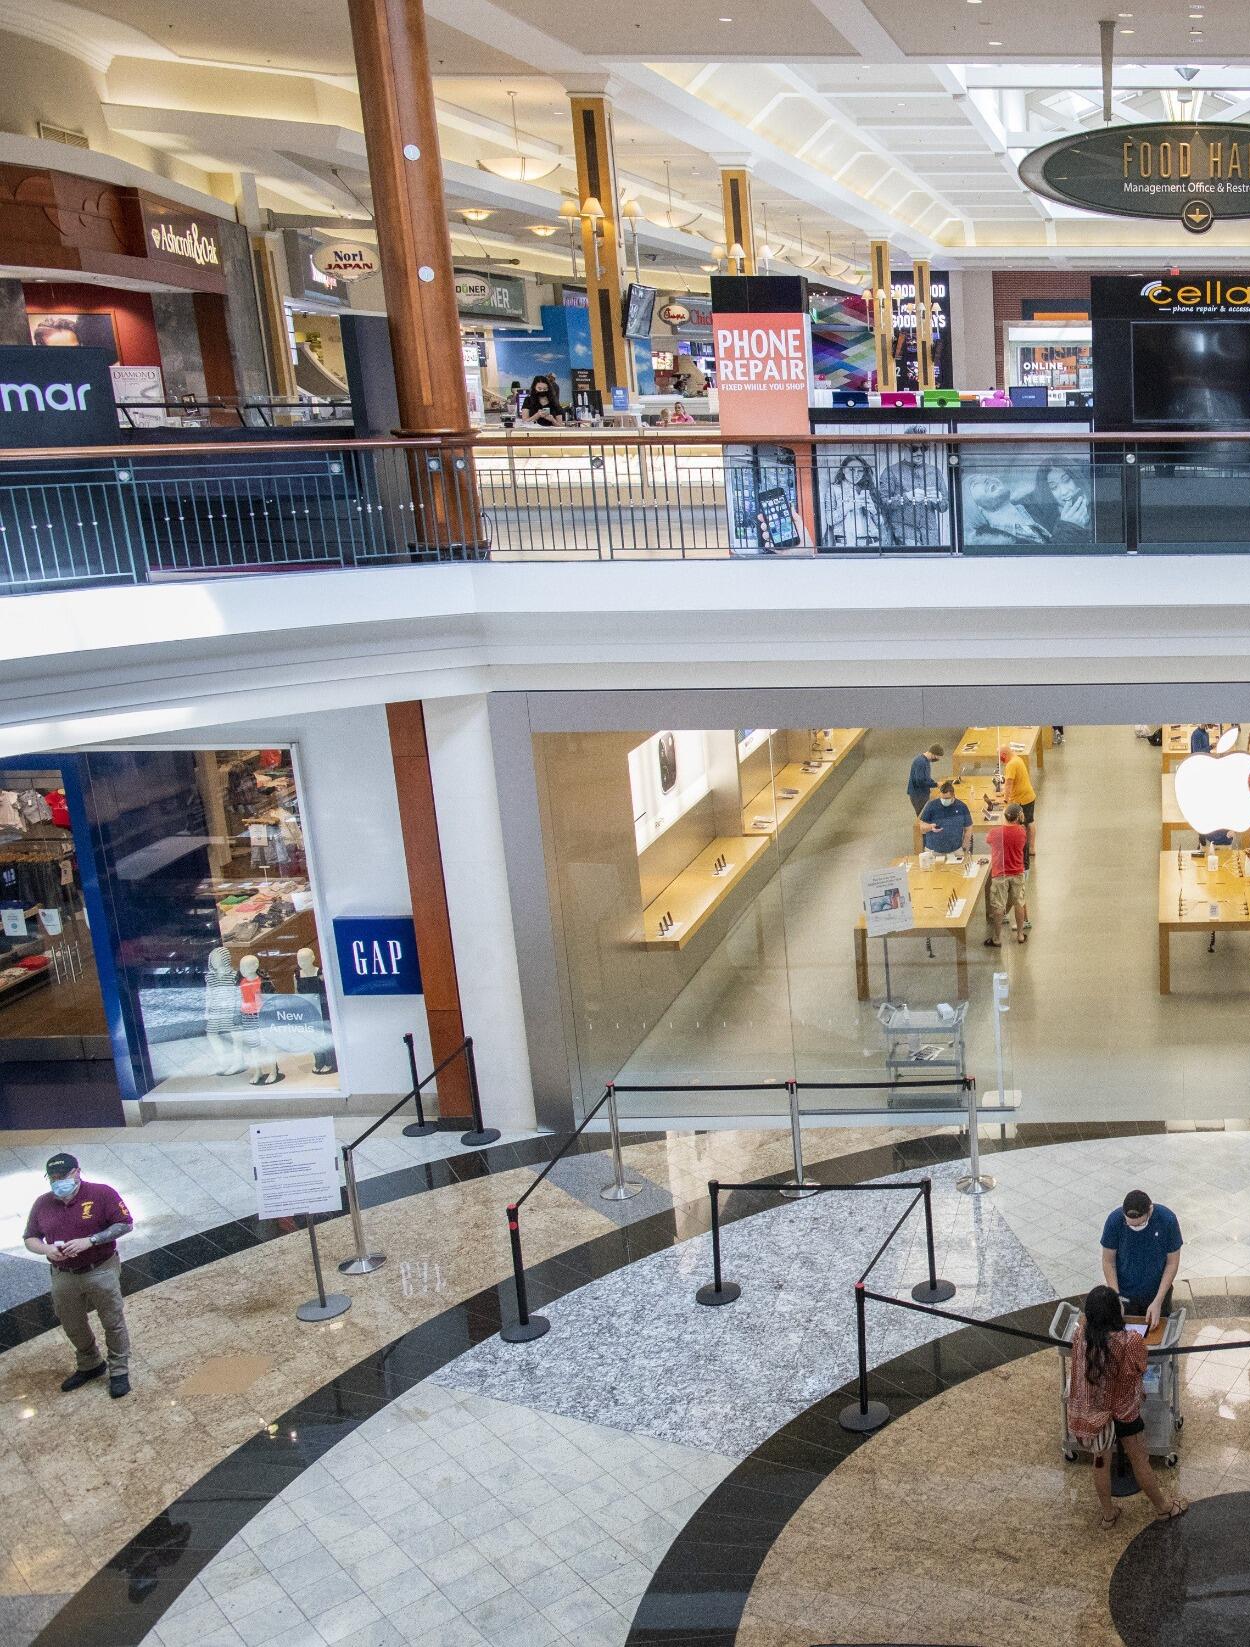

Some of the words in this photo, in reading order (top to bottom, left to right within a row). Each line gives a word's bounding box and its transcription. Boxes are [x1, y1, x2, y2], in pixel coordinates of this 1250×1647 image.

[1123, 142, 1192, 179] FOOD
[1123, 182, 1186, 195] Management
[1187, 182, 1214, 193] Office
[1217, 182, 1225, 193] &
[333, 250, 364, 262] Nori
[324, 262, 374, 271] JAPAN
[455, 284, 486, 294] DÖNER
[489, 287, 510, 309] NER
[1172, 305, 1194, 314] phone
[1196, 305, 1217, 314] repair
[1219, 305, 1227, 313] &
[717, 329, 802, 358] PHONE
[719, 359, 805, 381] REPAIR
[1023, 362, 1067, 372] ONLINE,
[1023, 375, 1052, 385] MEET
[721, 383, 743, 391] FIXED
[743, 383, 768, 391] WHILE
[769, 383, 785, 391] YOU
[785, 383, 805, 391] SHOP
[352, 940, 402, 976] GAP
[276, 1010, 304, 1021] New
